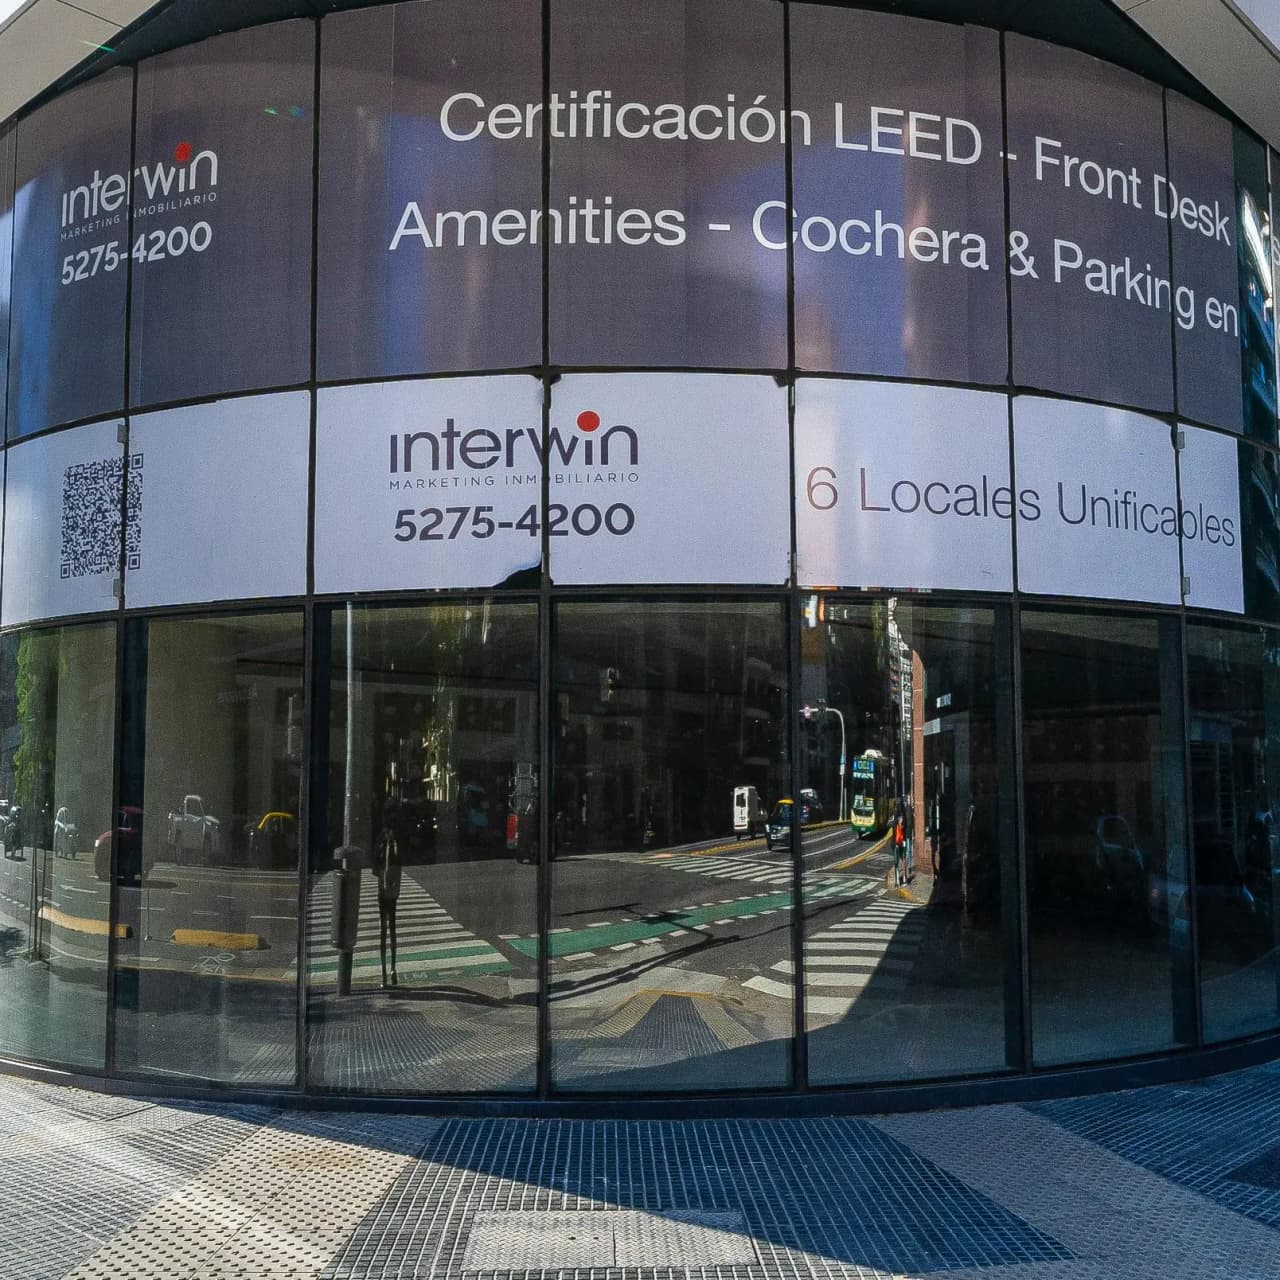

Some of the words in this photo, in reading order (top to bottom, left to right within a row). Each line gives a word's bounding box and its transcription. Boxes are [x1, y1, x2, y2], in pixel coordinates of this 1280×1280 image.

[61, 140, 219, 228] interwin
[439, 90, 812, 146] Certificación
[834, 101, 983, 165] LEED
[1034, 136, 1143, 209] Front
[1153, 173, 1232, 246] Desk
[60, 214, 121, 242] MARKETING
[60, 220, 213, 286] 5275-4200
[388, 196, 688, 251] Amenities
[752, 200, 990, 271] Cochera
[1008, 230, 1039, 279] &
[1053, 238, 1196, 330] Parking
[1205, 296, 1239, 337] en
[389, 410, 639, 474] interwin
[389, 475, 495, 490] MARKETING
[505, 472, 640, 486] INMBILIARIO
[806, 466, 839, 511] 6
[859, 467, 1042, 521] Locales
[1057, 481, 1236, 548] Unificables
[393, 502, 636, 542] 5275-4200
